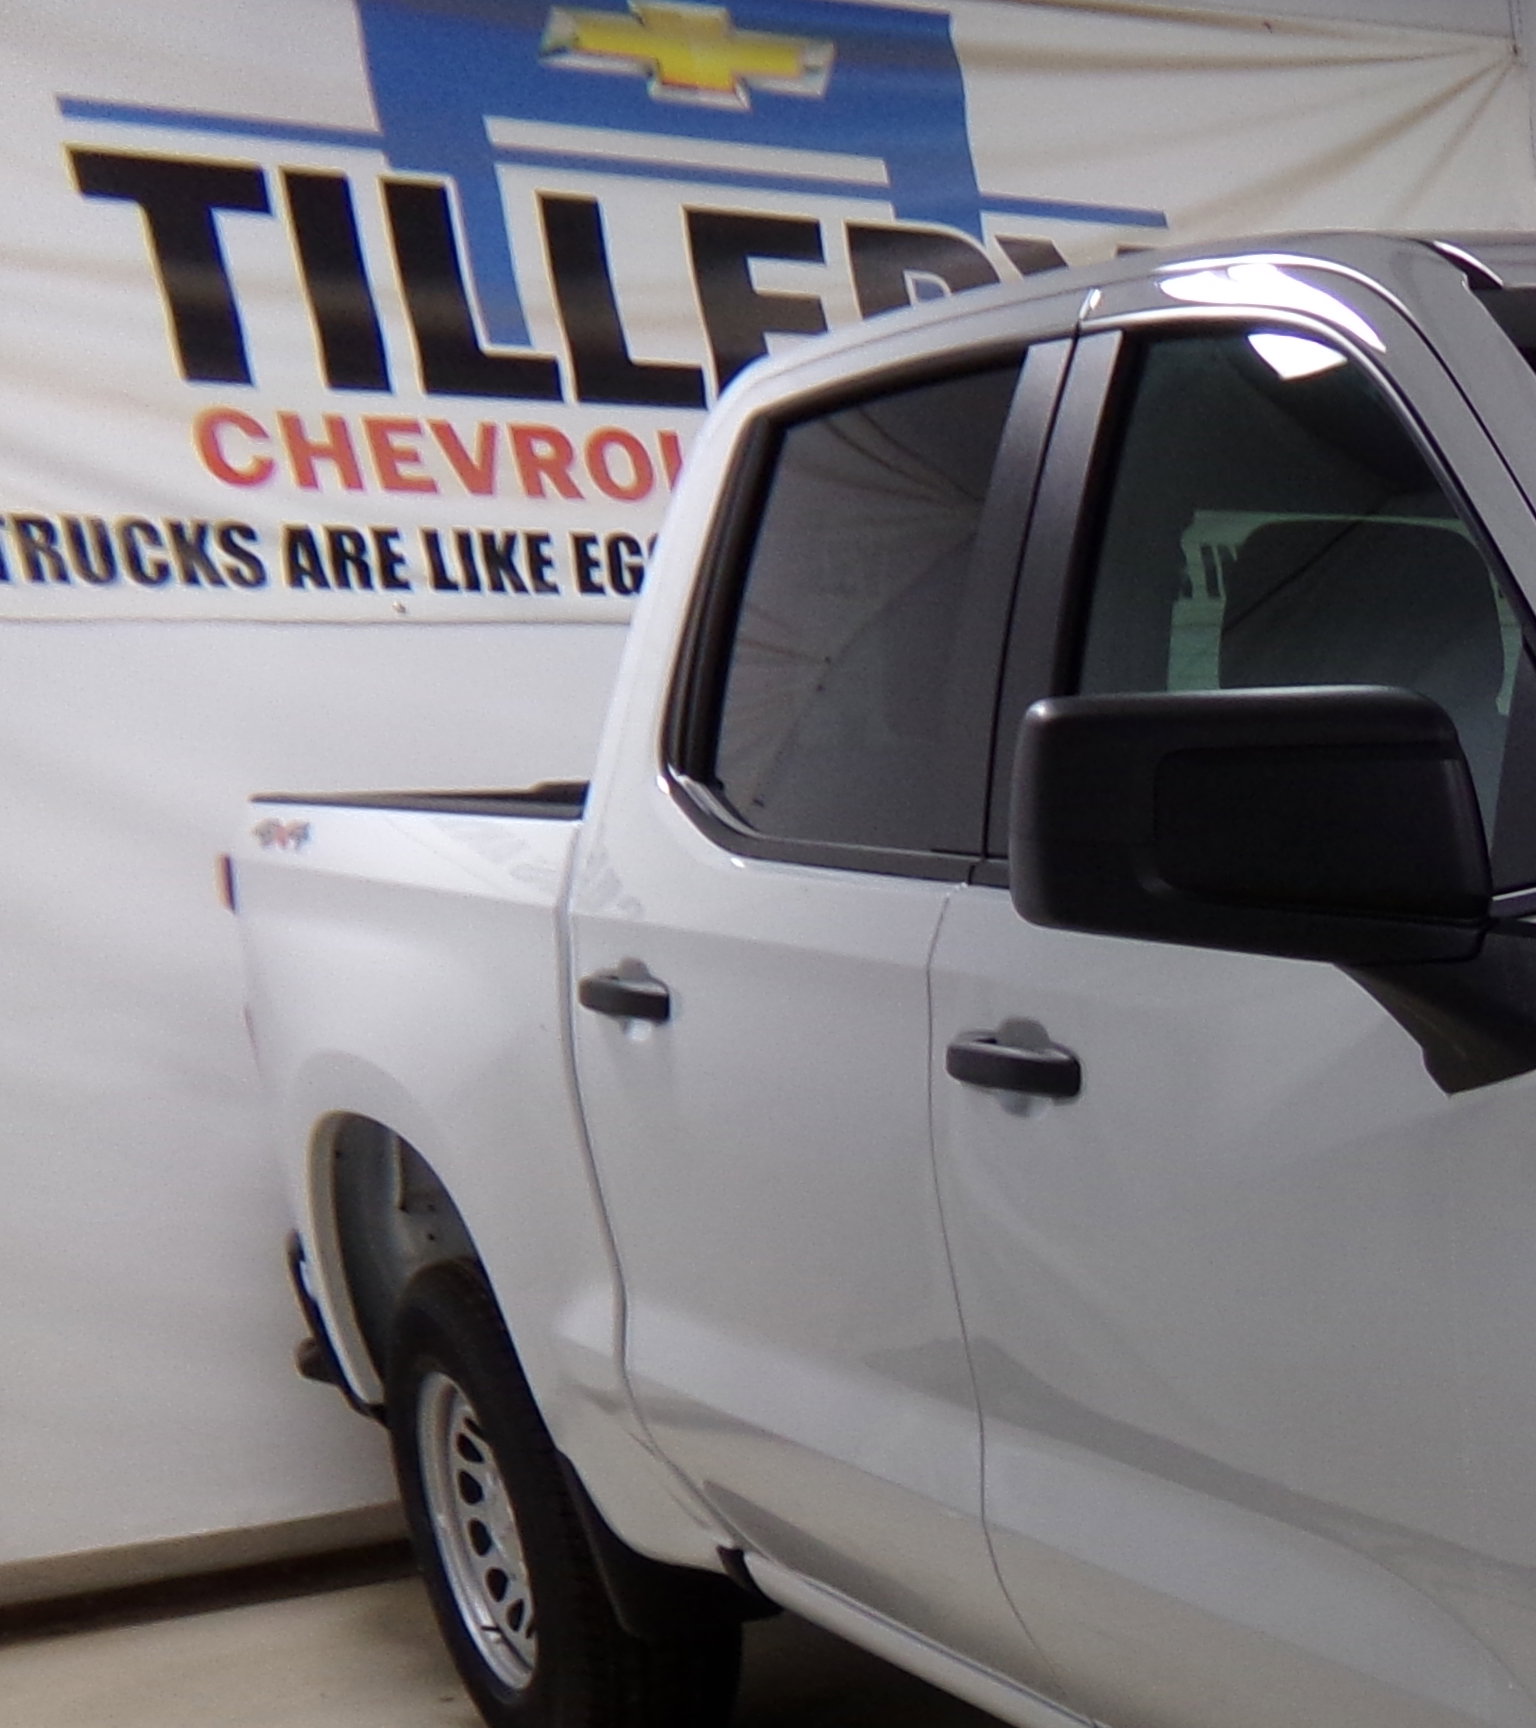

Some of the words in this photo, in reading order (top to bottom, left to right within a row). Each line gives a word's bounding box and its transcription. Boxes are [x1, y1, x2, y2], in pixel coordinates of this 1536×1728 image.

[0, 513, 268, 589] RUCKS
[280, 522, 411, 592] ARE
[422, 526, 561, 596] LIKE
[568, 530, 658, 597] EG
